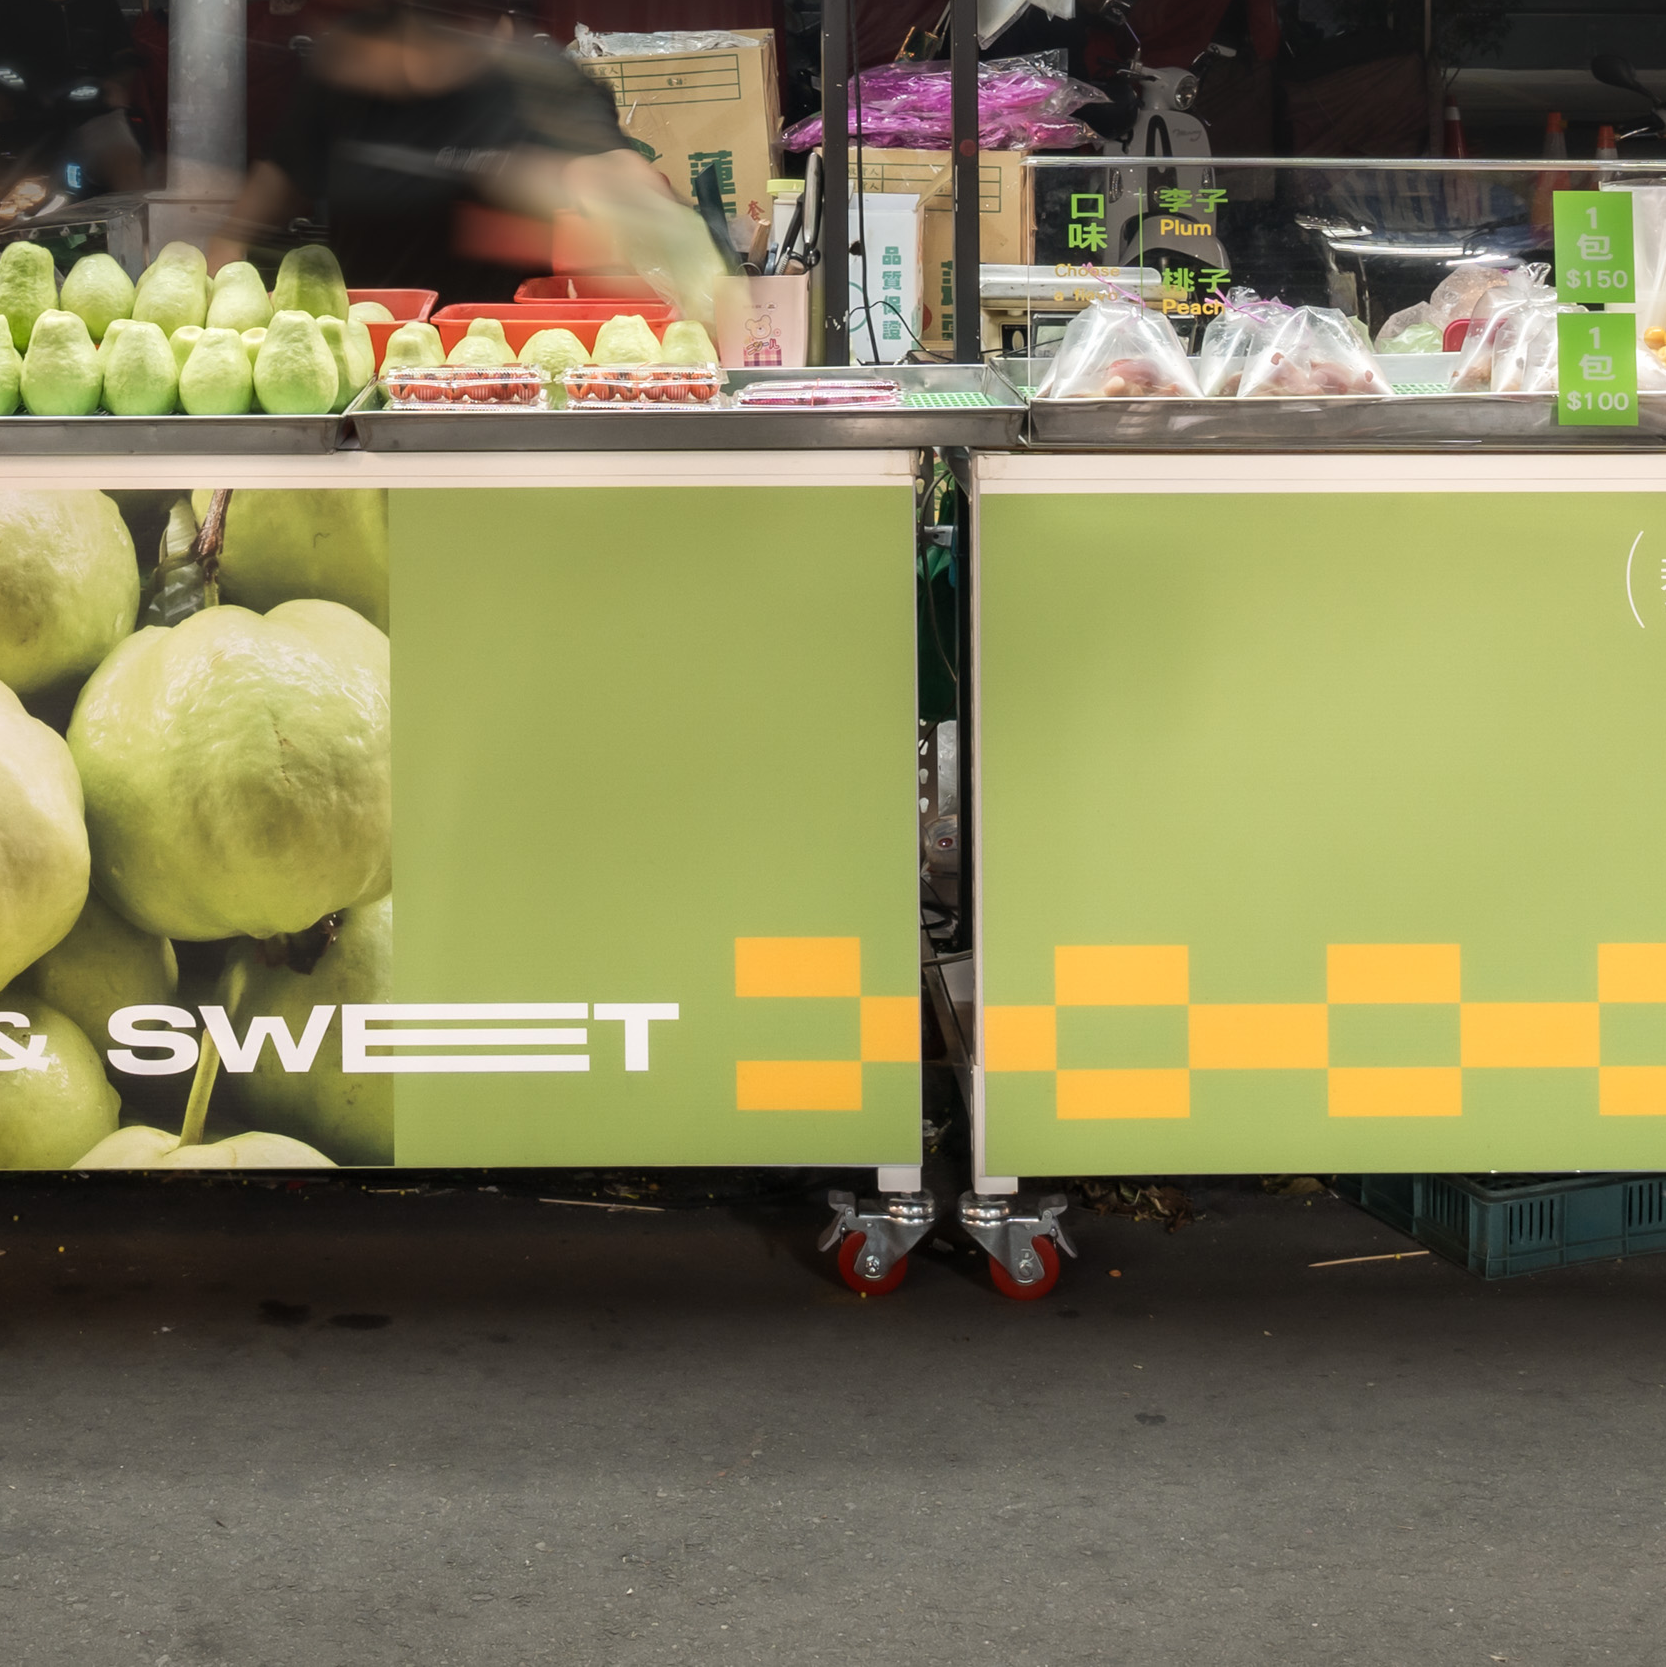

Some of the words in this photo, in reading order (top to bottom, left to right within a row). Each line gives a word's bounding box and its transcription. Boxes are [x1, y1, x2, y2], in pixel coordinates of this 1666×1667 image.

[1159, 188, 1228, 213] 李子
[1068, 193, 1108, 252] 口味
[1160, 219, 1212, 235] Plum
[1055, 263, 1121, 277] Choose
[1161, 267, 1231, 293] 桃子
[1566, 268, 1628, 289] $150
[882, 246, 902, 341] 品質保證
[1163, 298, 1225, 315] Peach
[1567, 390, 1629, 411] $100
